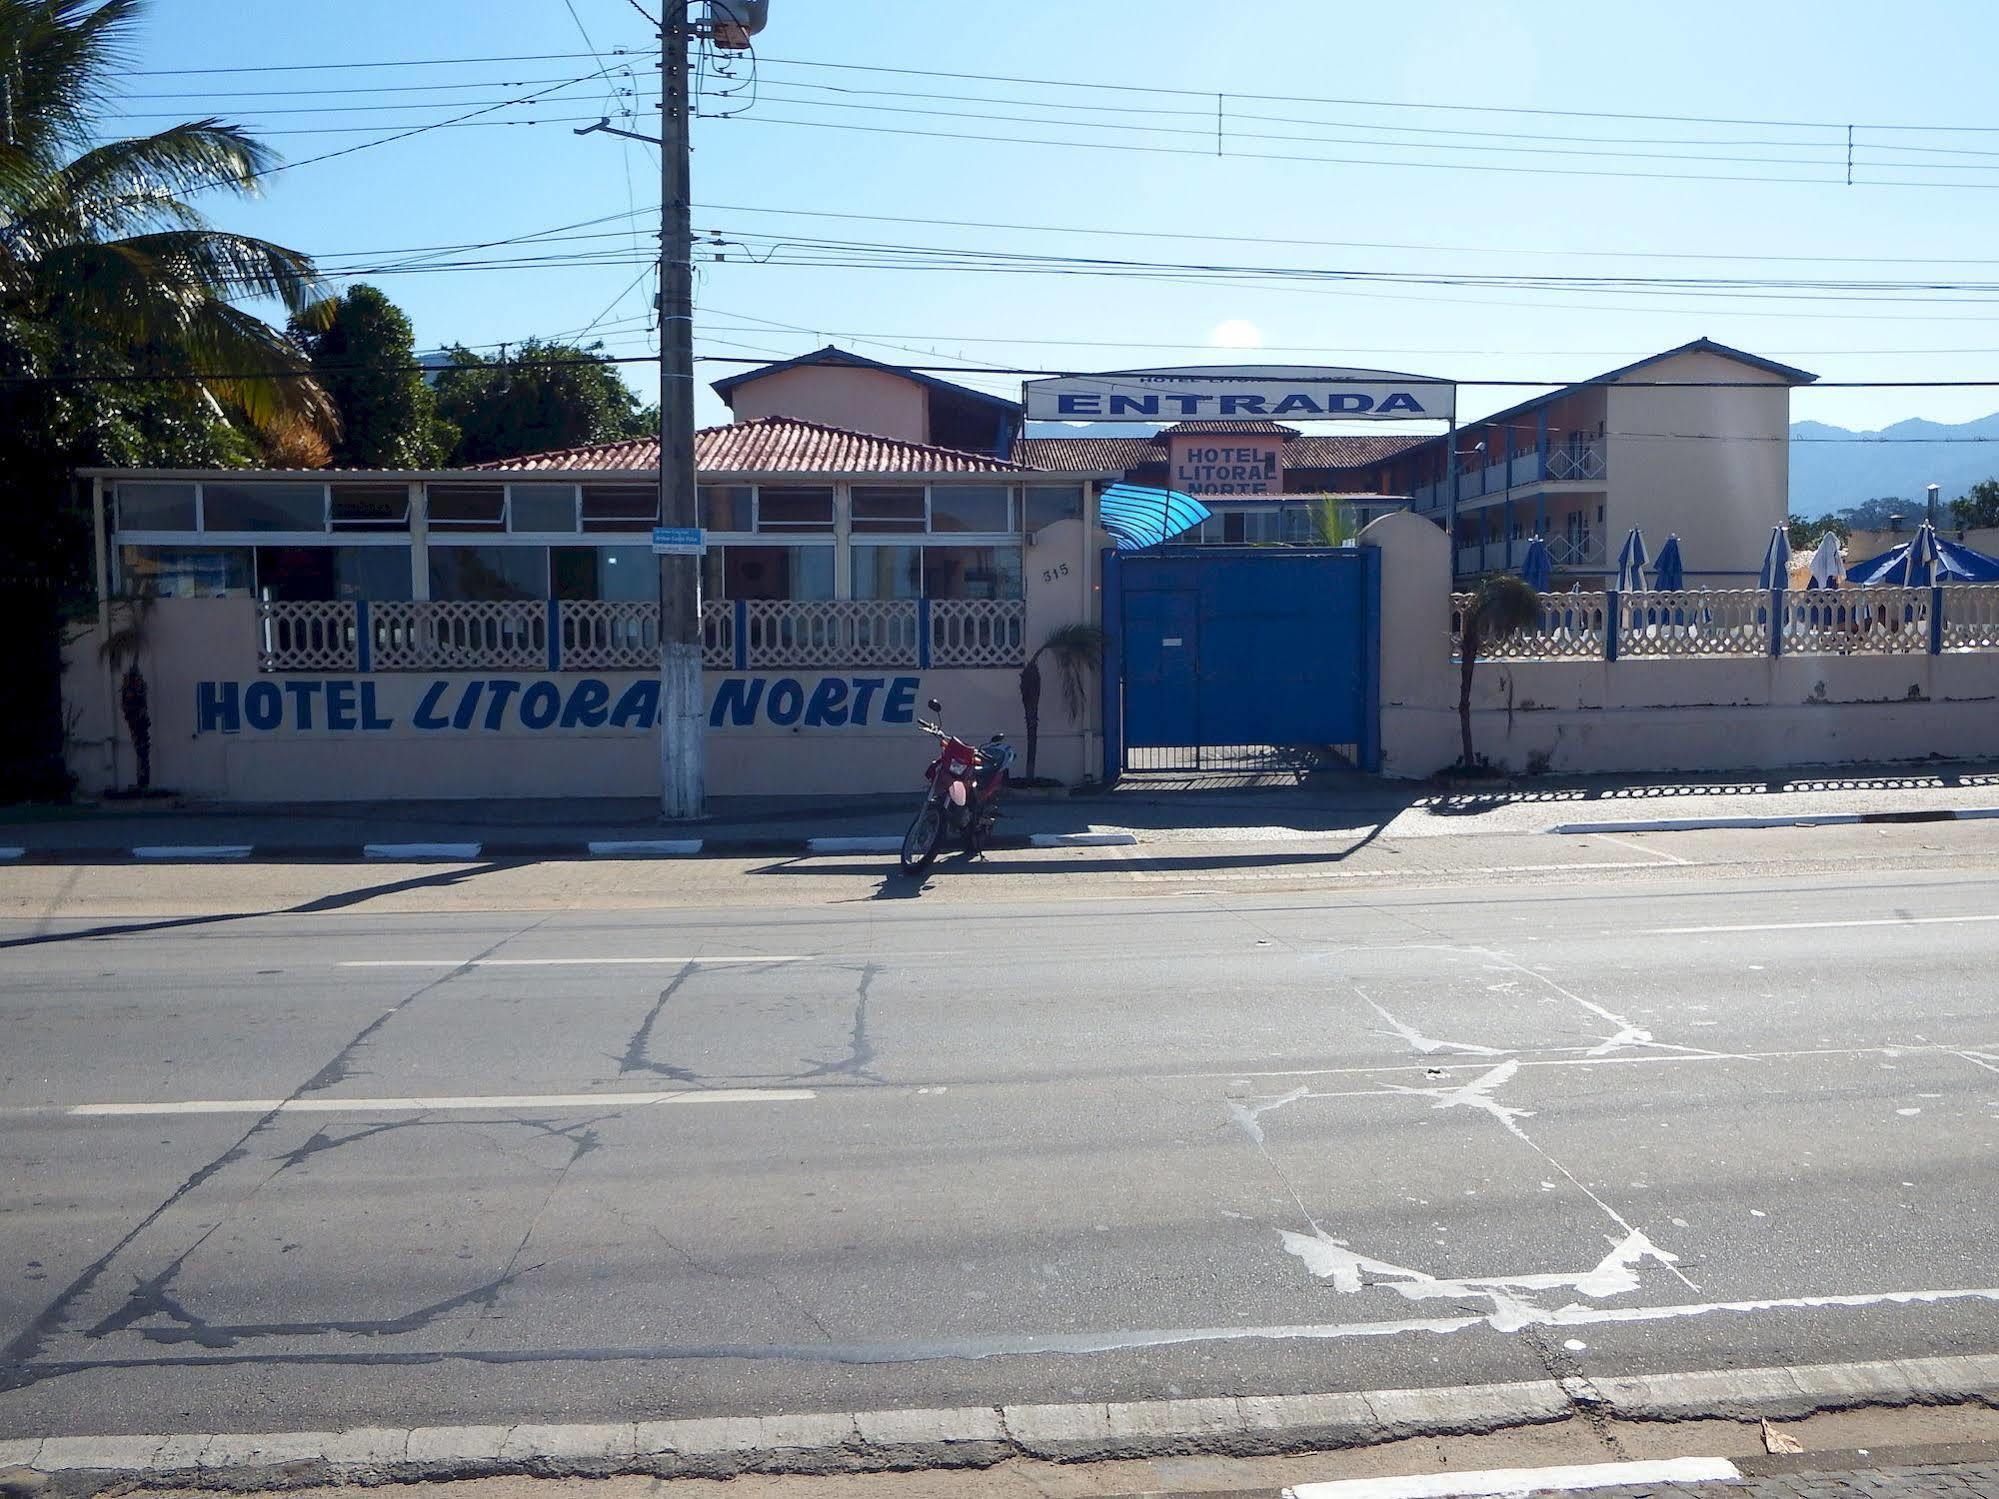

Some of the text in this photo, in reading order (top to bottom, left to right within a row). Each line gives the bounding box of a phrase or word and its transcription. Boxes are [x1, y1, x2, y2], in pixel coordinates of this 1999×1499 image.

[1058, 393, 1426, 415] ENTRADA
[1187, 448, 1266, 463] HOTEL
[1042, 563, 1070, 583] 315
[197, 677, 920, 732] HOTEL LITORA NORTE
